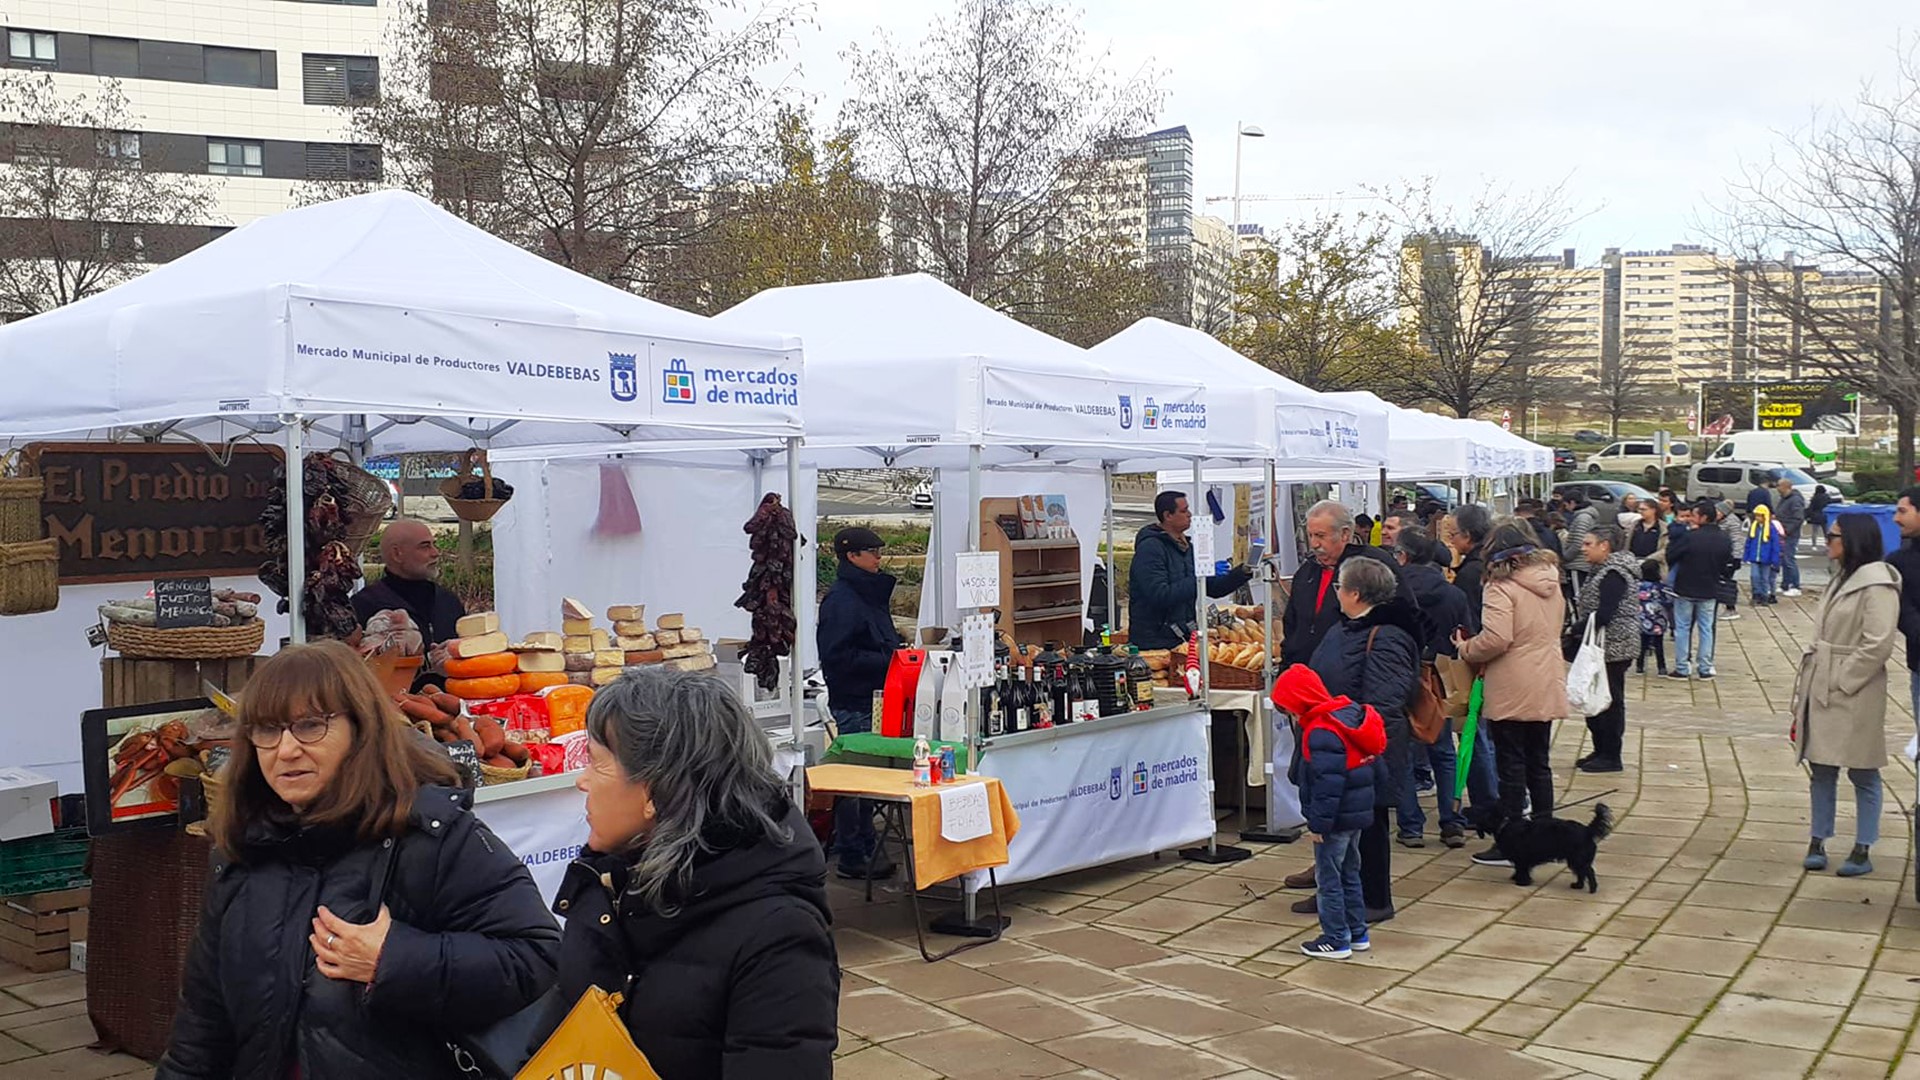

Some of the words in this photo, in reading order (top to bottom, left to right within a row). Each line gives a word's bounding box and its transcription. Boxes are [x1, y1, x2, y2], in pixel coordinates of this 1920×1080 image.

[297, 344, 348, 358] Mercado
[352, 349, 411, 364] Municipal
[415, 354, 430, 365] de
[433, 356, 501, 373] Productores
[506, 361, 601, 382] VALDEBEBAS
[704, 367, 798, 386] mercados
[706, 384, 729, 403] de
[735, 387, 798, 406] madrid
[1008, 400, 1034, 410] Municipal
[1074, 404, 1116, 416] VALDEBEBAS
[1163, 400, 1206, 414] mercados
[1162, 414, 1173, 428] de
[1174, 415, 1206, 429] madrid
[44, 465, 86, 503] El
[102, 458, 230, 502] Predio
[961, 577, 986, 588] VASOS
[159, 593, 194, 606] FUET
[970, 589, 995, 604] VINO
[1152, 756, 1197, 774] mercados
[1151, 777, 1163, 790] de
[1164, 769, 1197, 787] madrid
